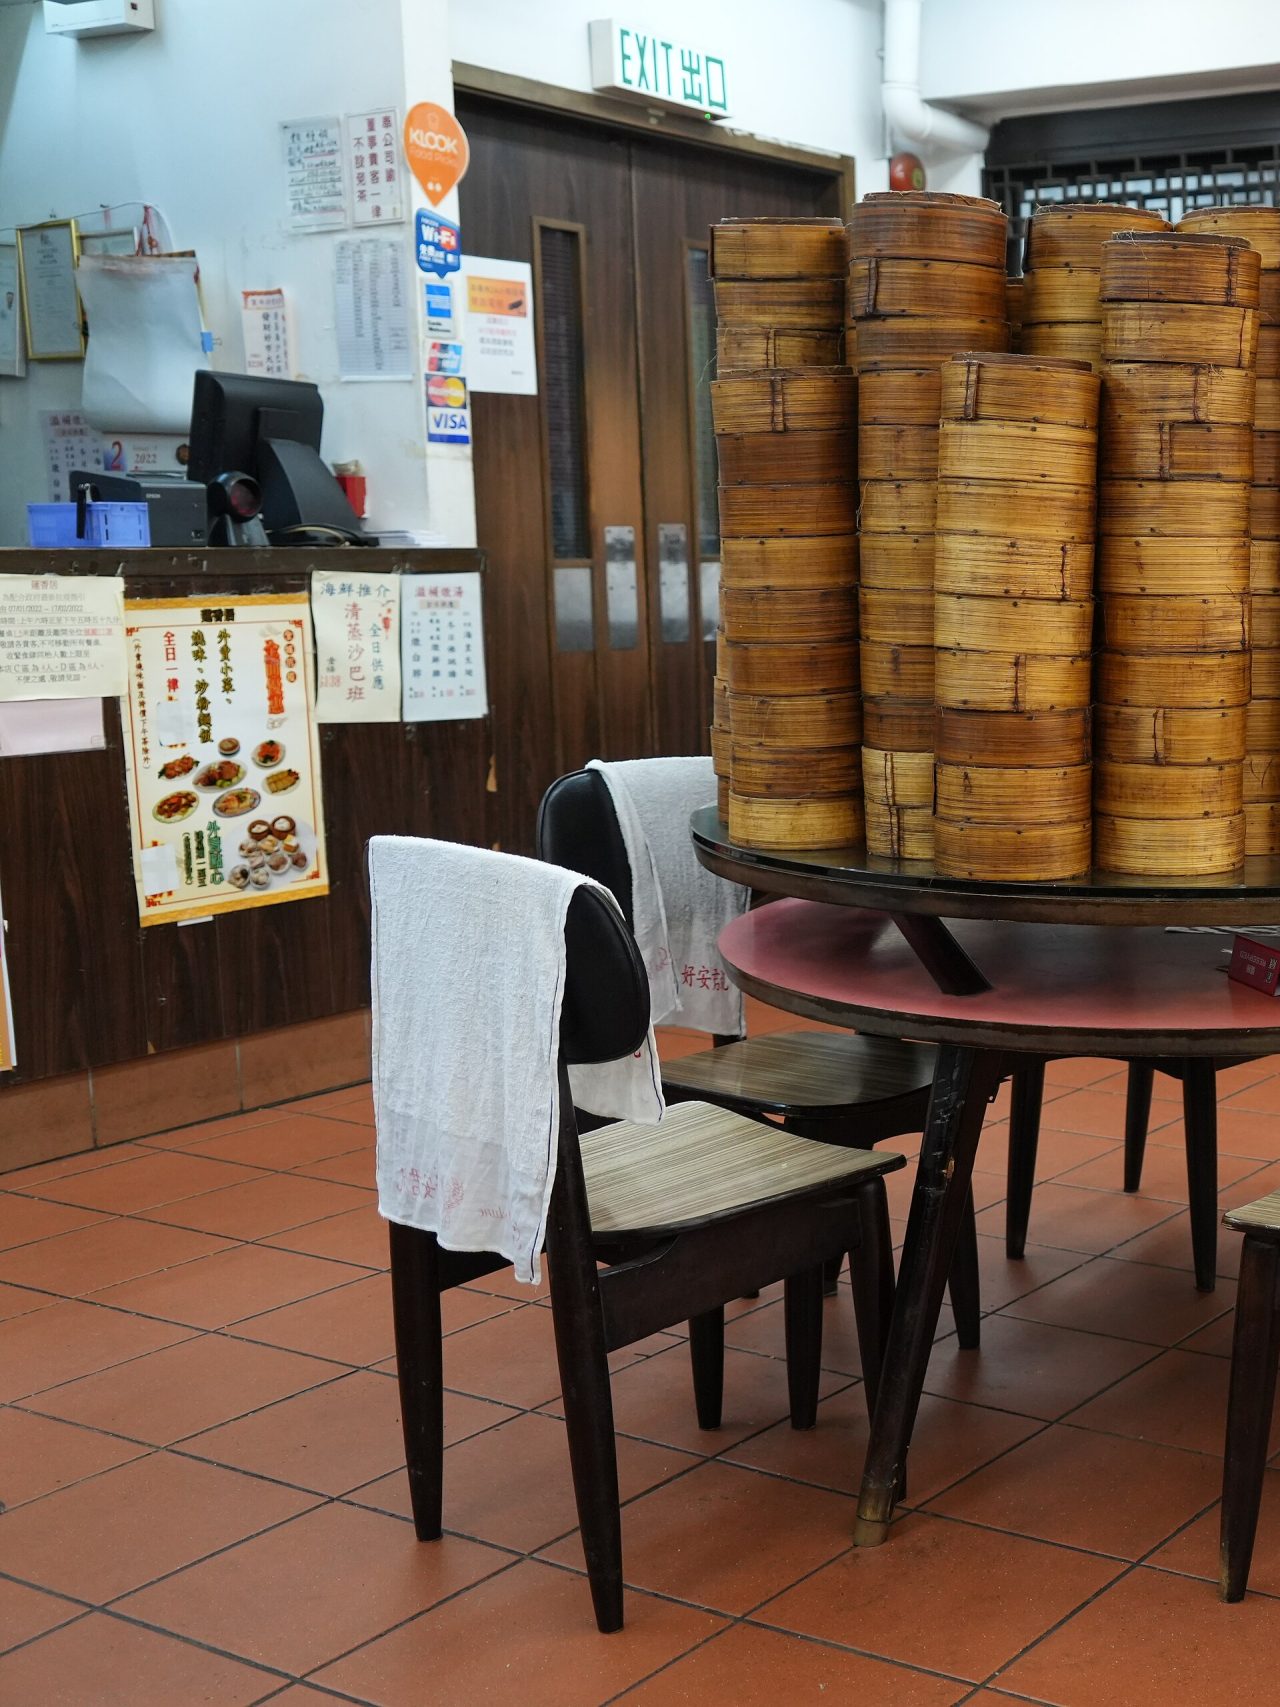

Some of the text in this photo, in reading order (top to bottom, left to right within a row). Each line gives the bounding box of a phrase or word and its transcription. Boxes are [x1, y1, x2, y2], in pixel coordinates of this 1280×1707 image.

[620, 28, 727, 110] EXIT 出口
[409, 128, 458, 153] KLOOK
[421, 225, 457, 246] Wi-Fi
[433, 414, 467, 430] VISA
[111, 441, 123, 471] 2
[134, 454, 157, 463] 2022
[320, 582, 391, 598] 海鮮推介
[163, 631, 179, 692] 全日一律
[369, 623, 385, 690] 全日供應
